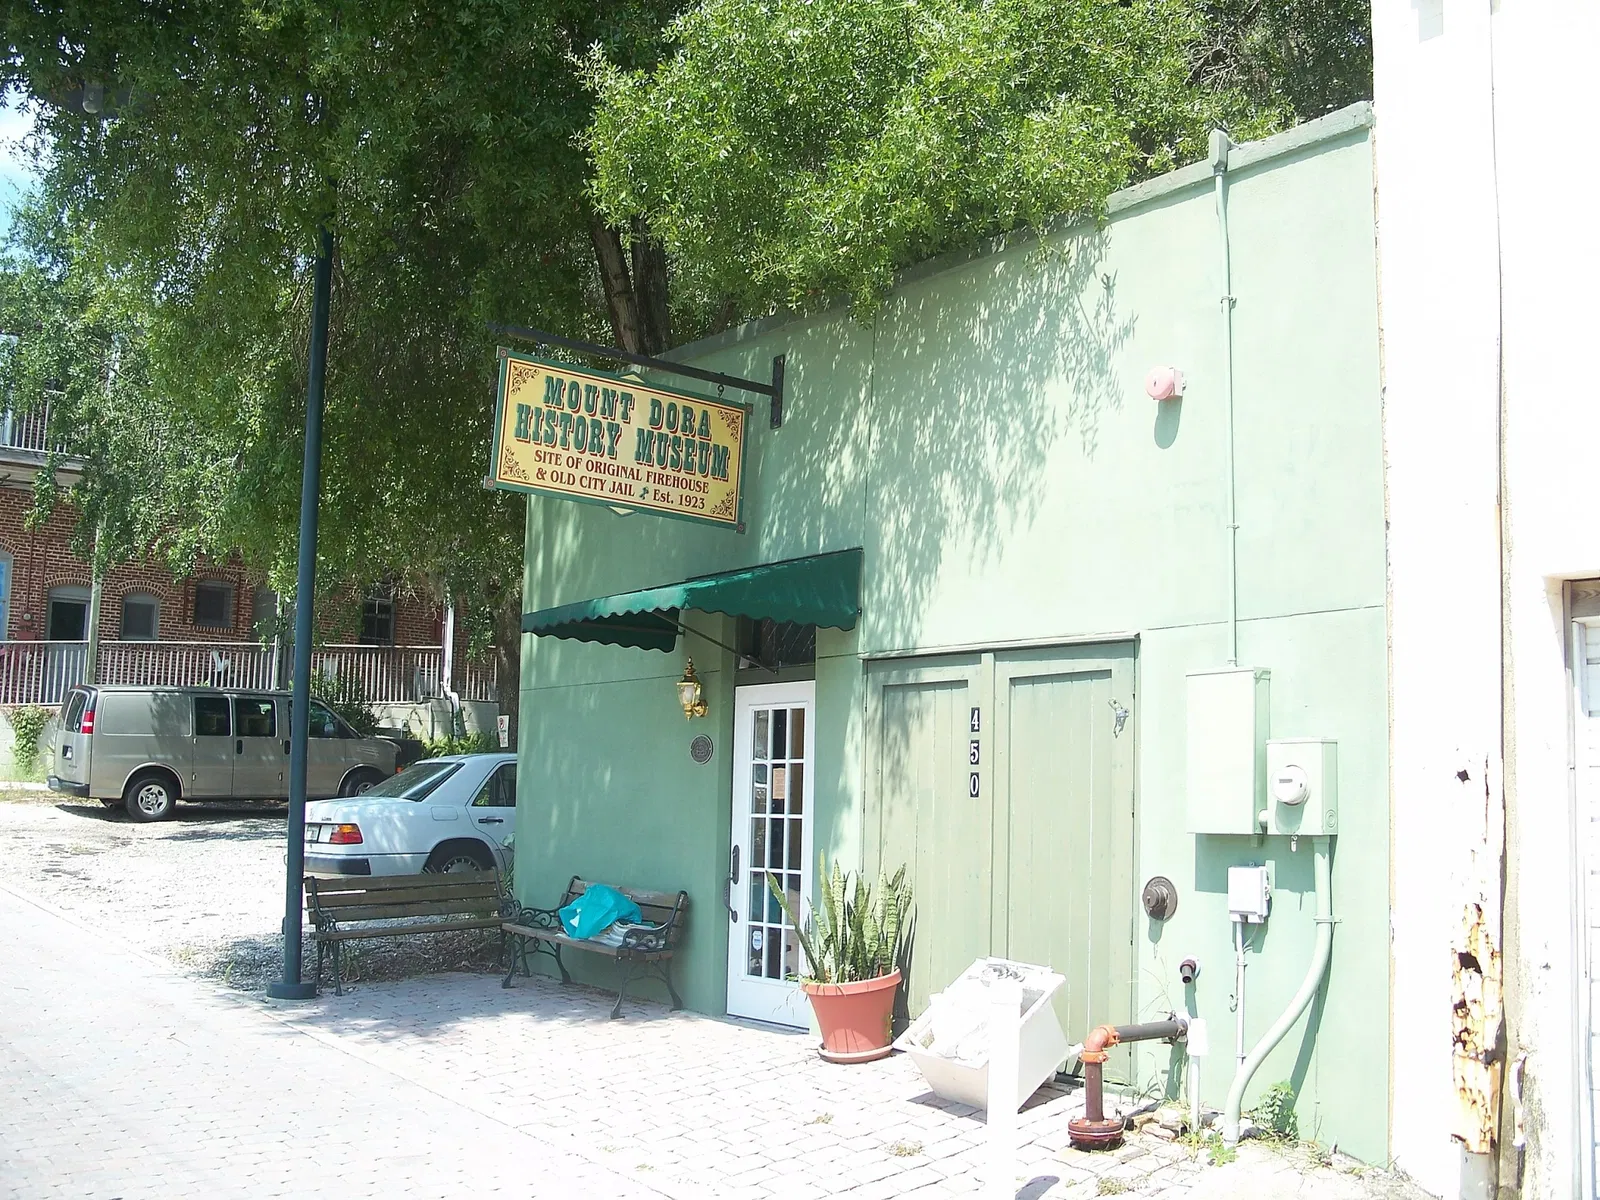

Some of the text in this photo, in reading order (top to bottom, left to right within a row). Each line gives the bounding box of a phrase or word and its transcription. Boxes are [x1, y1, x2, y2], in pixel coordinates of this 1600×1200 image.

[543, 375, 712, 441] MOUNT DORA
[514, 403, 731, 482] HISTORY MUSEUM
[534, 450, 709, 494] SITE OF ORIGINAL FIREHOUSE
[536, 467, 705, 510] & OLD CITY JAIL Est. 1923
[970, 708, 979, 796] 450
